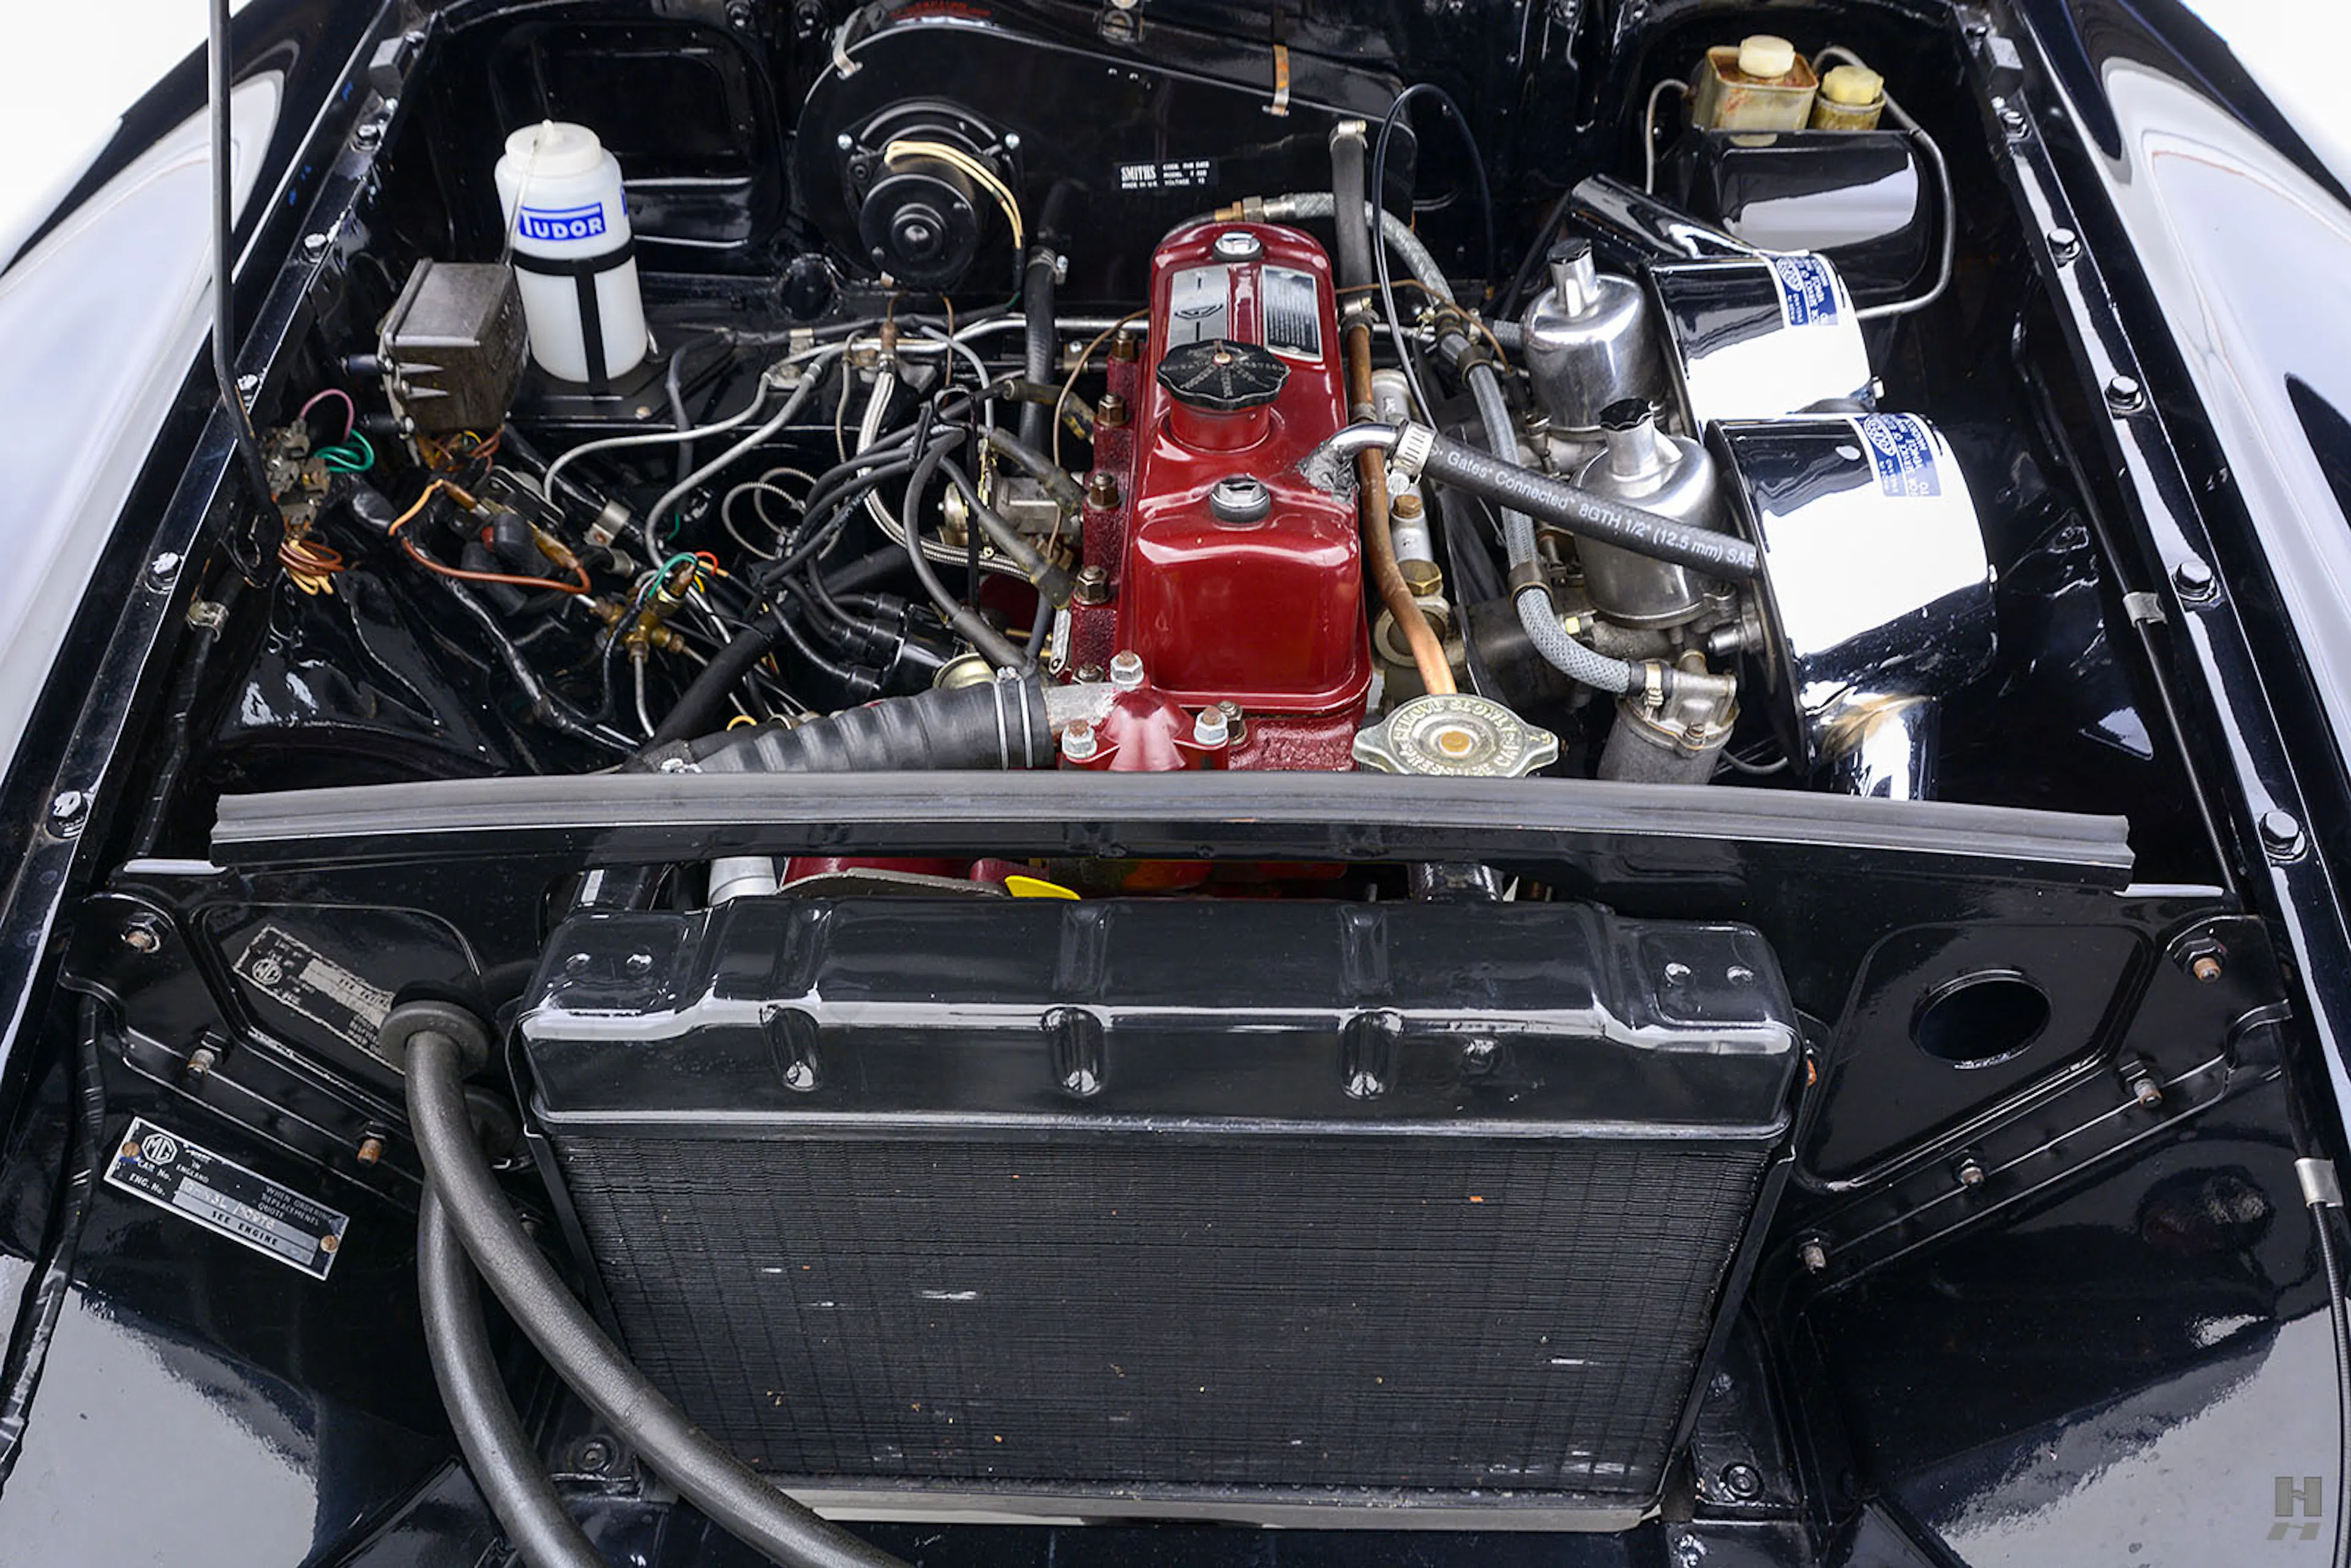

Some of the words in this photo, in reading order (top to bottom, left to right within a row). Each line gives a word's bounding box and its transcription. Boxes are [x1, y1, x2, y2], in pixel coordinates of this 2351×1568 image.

[1120, 164, 1157, 182] SMITHS
[522, 204, 603, 239] TUDOR
[1653, 527, 1690, 551] (12.5
[1691, 543, 1723, 563] mm)
[1726, 548, 1756, 569] SAE
[143, 1135, 176, 1163] MG
[176, 1163, 210, 1184] ENGLAND
[257, 1202, 285, 1220] QUOTE
[261, 1193, 318, 1226] REPLACEMENTS
[266, 1185, 291, 1202] WHEN
[293, 1198, 334, 1222] ORDERING
[211, 1210, 231, 1225] SEE
[238, 1221, 279, 1247] ENGINE
